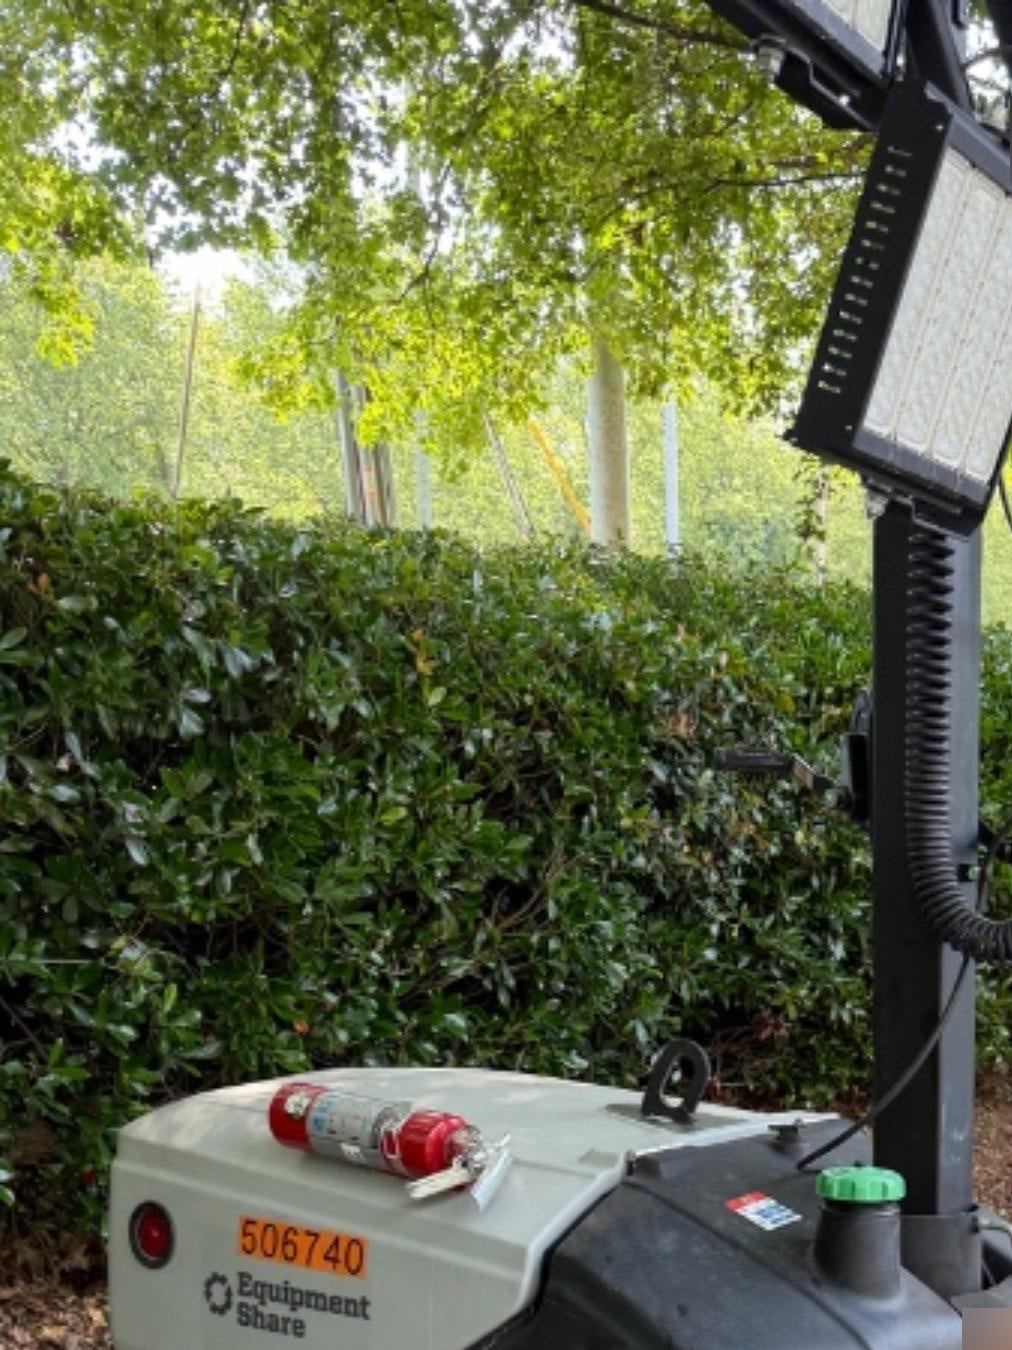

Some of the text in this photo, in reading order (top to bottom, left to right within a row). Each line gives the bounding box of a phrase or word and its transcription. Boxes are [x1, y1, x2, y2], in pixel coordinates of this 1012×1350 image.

[240, 1219, 365, 1276] 506740
[236, 1271, 370, 1321] Equipment
[236, 1301, 306, 1338] Share
